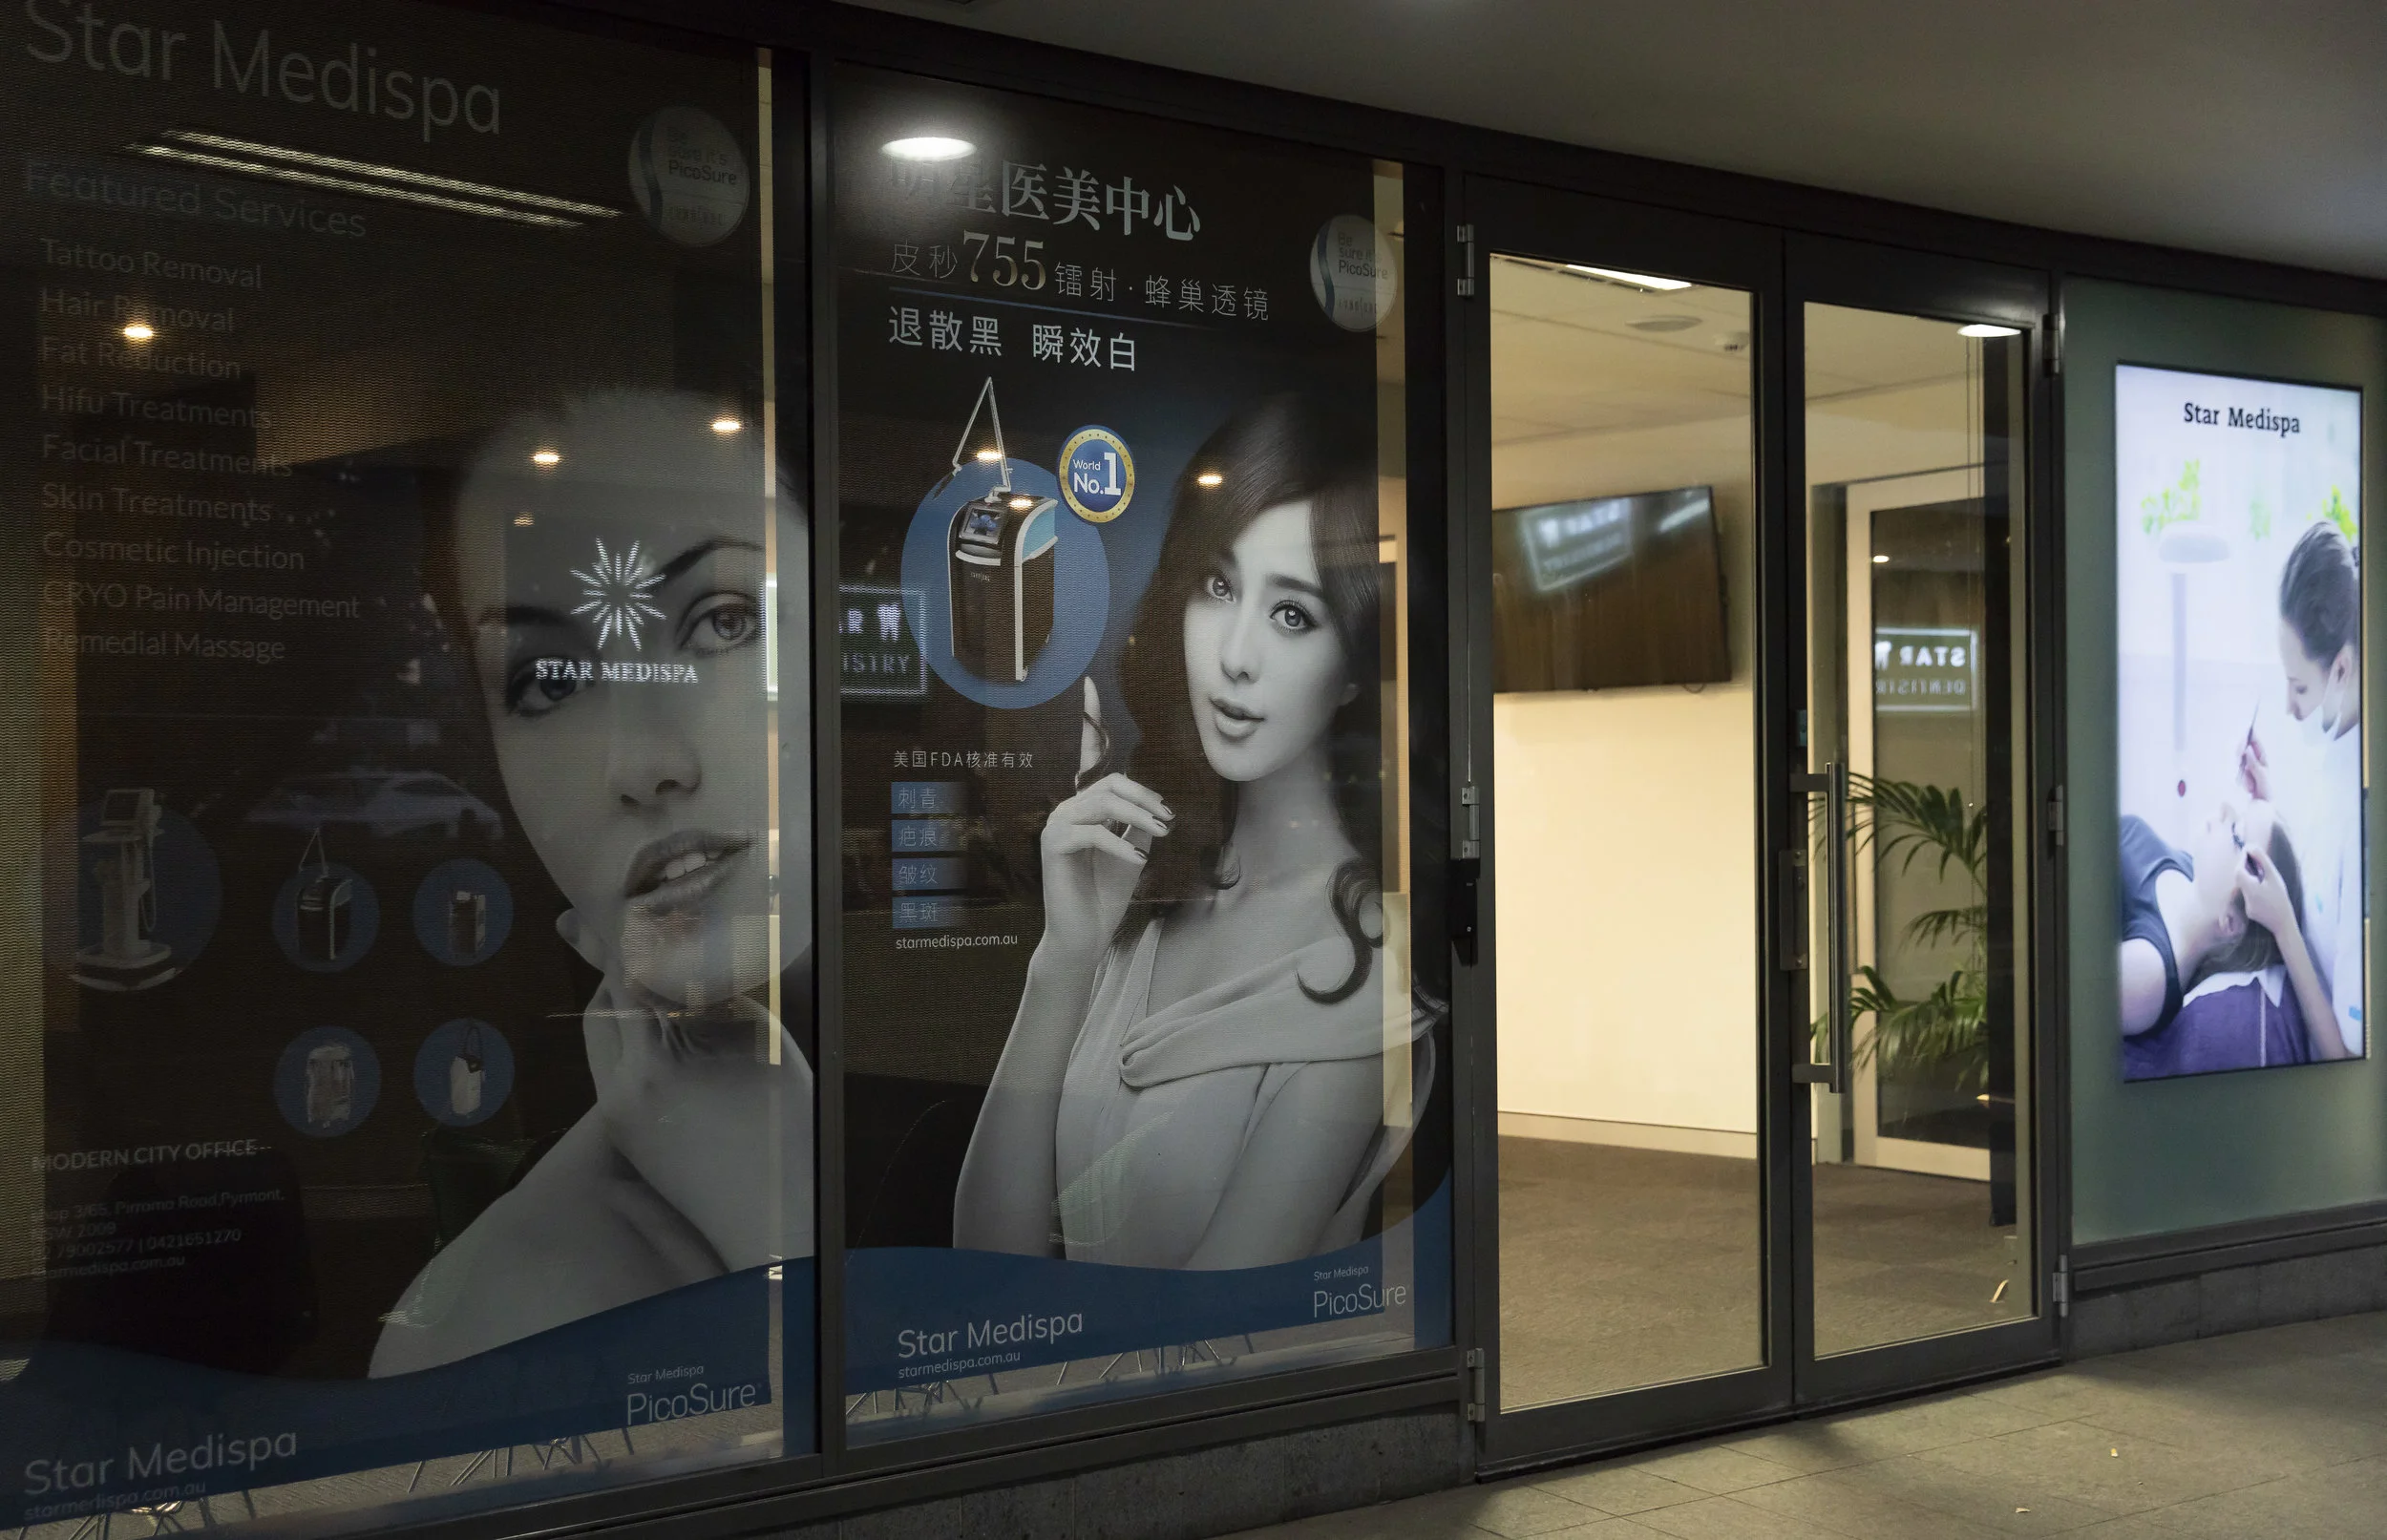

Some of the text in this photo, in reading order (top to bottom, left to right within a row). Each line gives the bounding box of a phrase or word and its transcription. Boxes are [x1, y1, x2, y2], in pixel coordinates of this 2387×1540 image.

[27, 0, 501, 141] Star Medispa
[667, 158, 737, 185] PicoSure
[25, 159, 368, 239] Featured Services
[41, 238, 262, 289] Tattoo Removal
[1339, 259, 1388, 280] PicoSure
[41, 289, 104, 318] Hair
[888, 306, 1136, 372] 退散黑 瞬效白
[41, 337, 242, 378] Fat Reduction
[41, 387, 272, 429] Hifu Treatments
[2184, 402, 2300, 438] Star Medispa
[42, 434, 292, 478] Facial Treatments
[1072, 458, 1101, 471] World
[42, 484, 271, 523] Skin Treatments
[42, 533, 305, 571] Cosmetic Injection
[43, 581, 360, 621] CRYO Pain Management
[44, 628, 285, 665] Remedial Massage
[535, 657, 699, 684] STAR MEDISPA
[893, 750, 1034, 769] 美国FDA核准有效
[898, 787, 938, 810] 刺青
[898, 825, 938, 848] 疤痕
[896, 934, 1019, 950] starmedispa.com.au
[32, 1138, 257, 1172] MODERN CITY OFFICE
[115, 1199, 176, 1215] Pirrama
[77, 1221, 116, 1238] 2009
[1314, 1266, 1369, 1281] Star Medispa
[1314, 1283, 1406, 1318] PicoSure
[898, 1313, 1084, 1359] Star Medispa
[627, 1365, 705, 1385] Star Medispa
[898, 1351, 1021, 1379] starmedispa.com.au
[626, 1382, 757, 1425] PicoSure
[24, 1432, 298, 1496] Star Medispa
[23, 1481, 207, 1522] starmedispa.com.au
